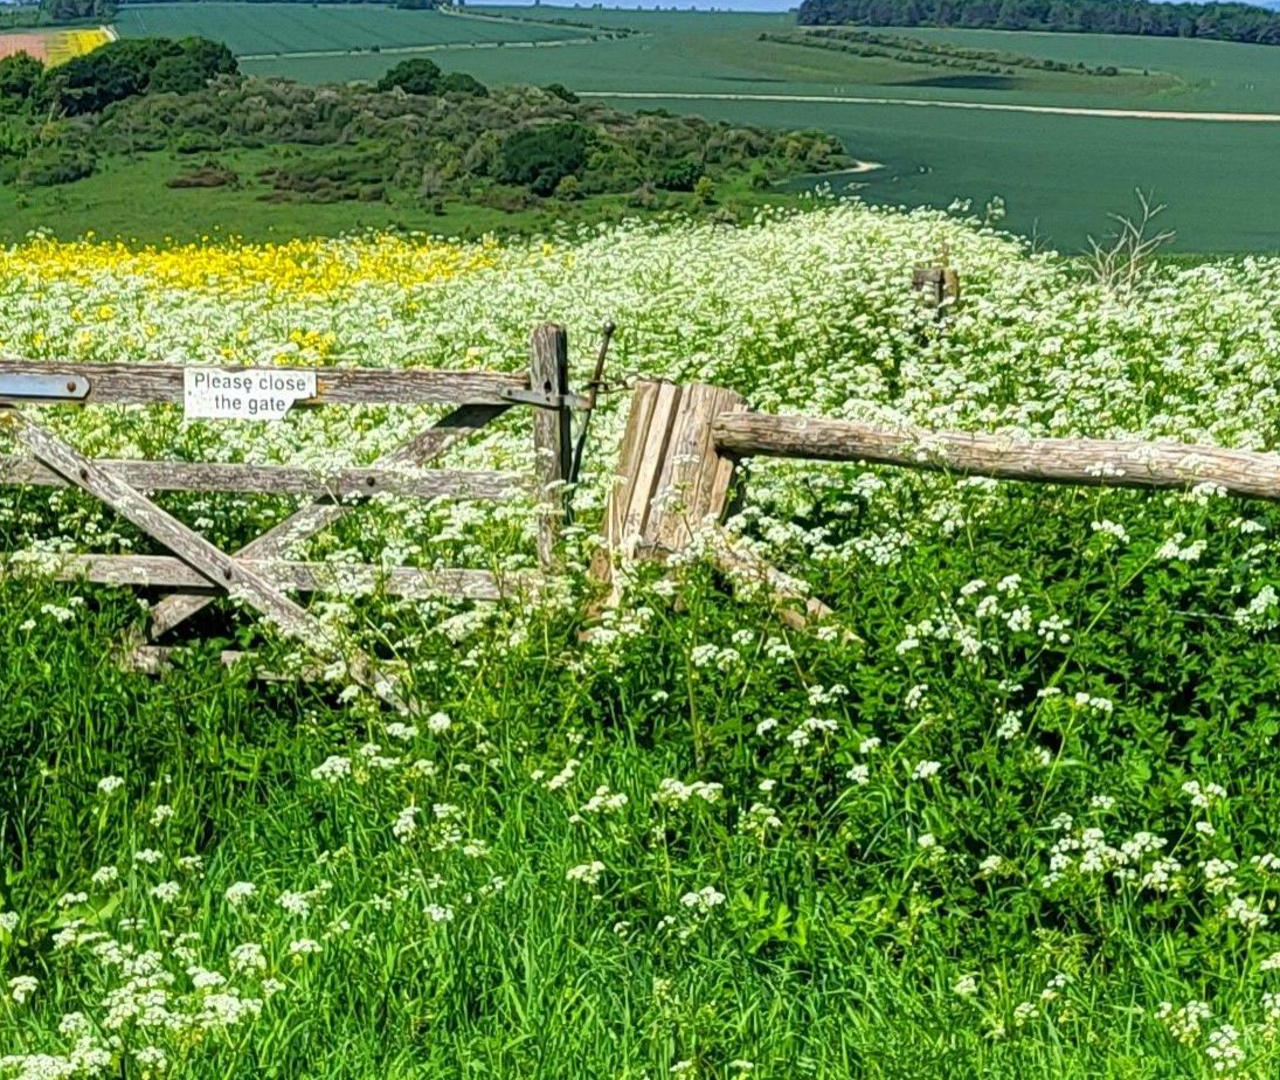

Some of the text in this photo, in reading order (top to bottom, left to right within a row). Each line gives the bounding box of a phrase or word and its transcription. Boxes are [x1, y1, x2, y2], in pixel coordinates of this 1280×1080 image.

[194, 372, 306, 391] Please close
[214, 395, 285, 415] the gate
